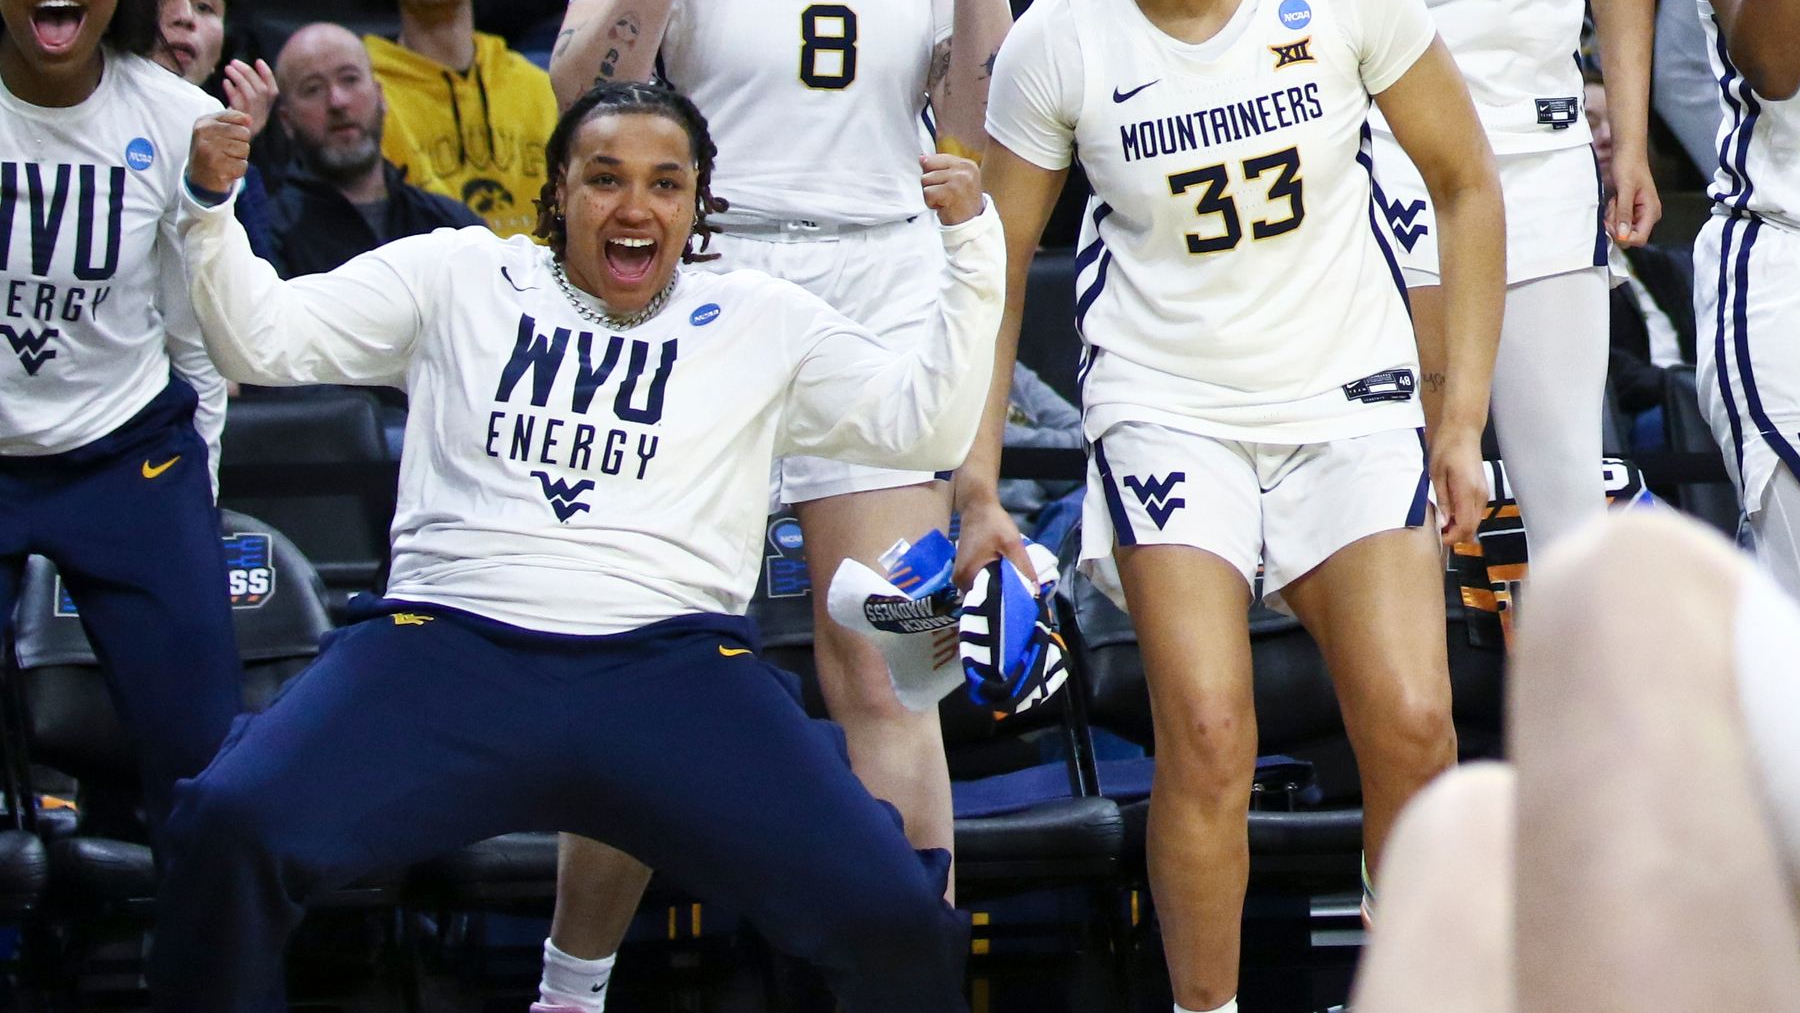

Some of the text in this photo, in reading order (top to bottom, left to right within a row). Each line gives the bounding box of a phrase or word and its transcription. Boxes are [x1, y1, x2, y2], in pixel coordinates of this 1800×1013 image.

[799, 3, 858, 91] 8
[1120, 82, 1324, 162] MOUNTAINEERS
[1165, 145, 1305, 254] 33
[494, 312, 678, 425] WVU
[486, 411, 659, 480] ENERGY
[865, 595, 934, 623] MADNESS
